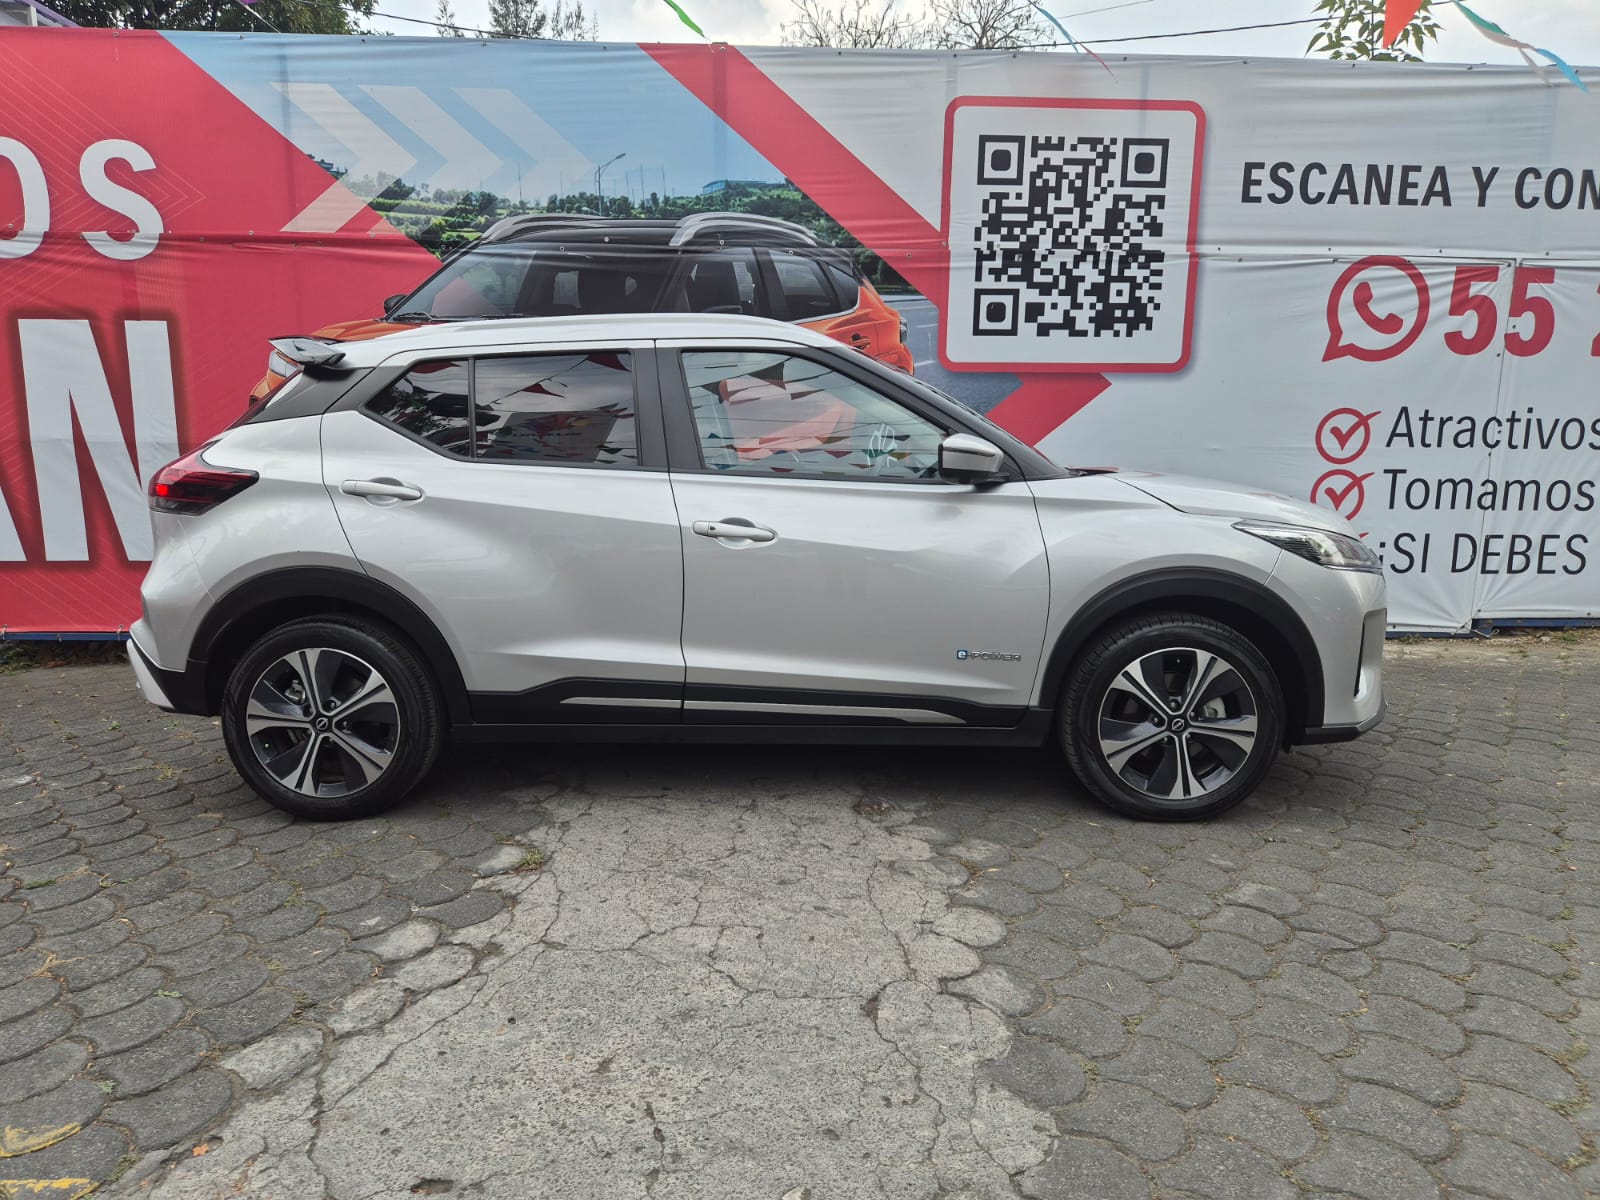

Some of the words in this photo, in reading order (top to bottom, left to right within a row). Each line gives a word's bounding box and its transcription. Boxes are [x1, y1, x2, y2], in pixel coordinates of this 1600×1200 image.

[1241, 161, 1452, 207] ESCANEA
[1472, 166, 1499, 207] Y
[1514, 167, 1600, 210] CON
[1443, 265, 1556, 357] 55
[0, 318, 180, 561] N
[1385, 406, 1600, 450] Atractivos
[1383, 468, 1596, 512] Tomamos
[1450, 533, 1589, 575] DEBES
[956, 649, 1022, 662] e-POWER
